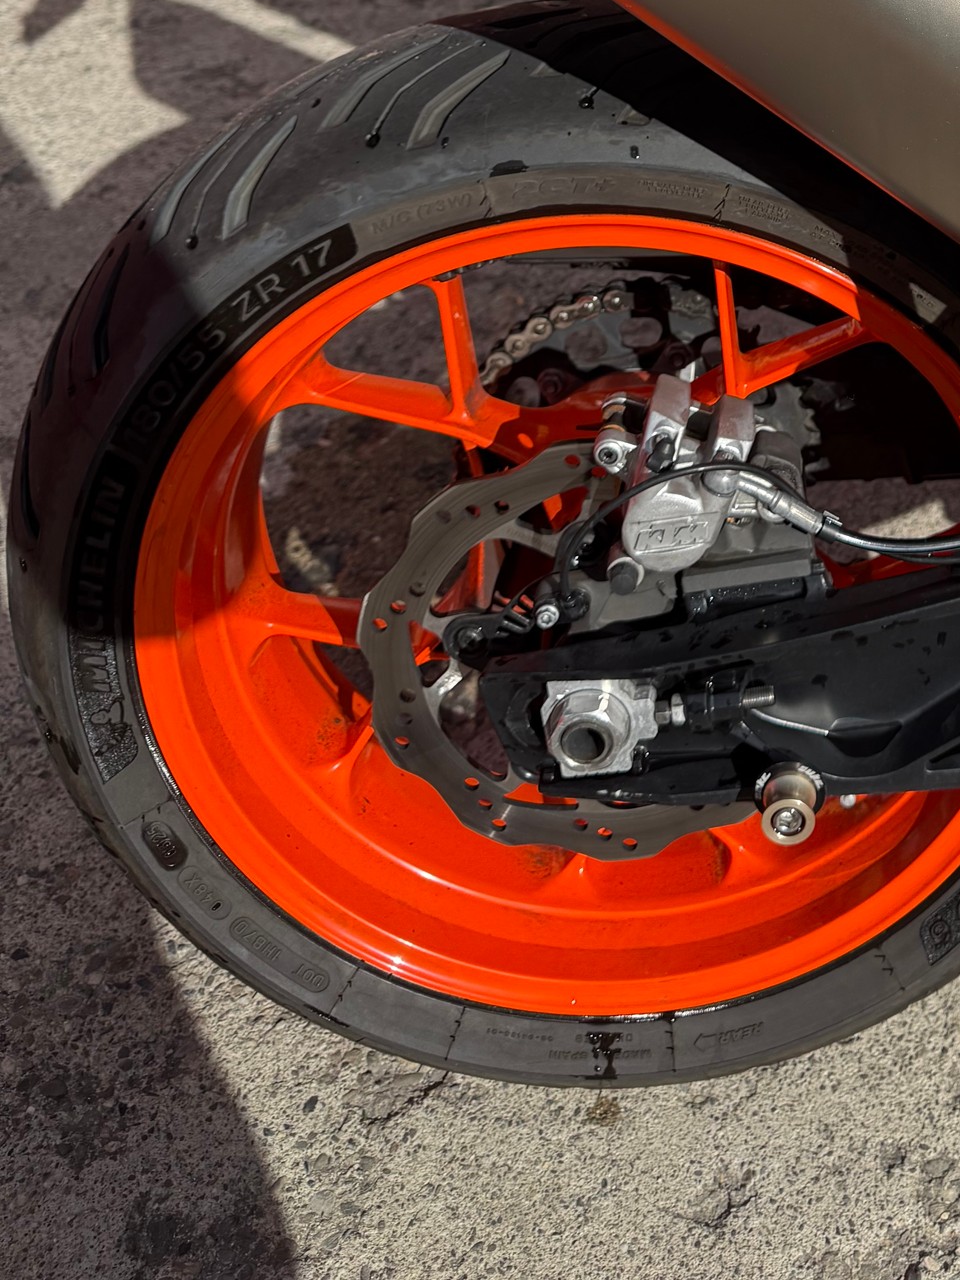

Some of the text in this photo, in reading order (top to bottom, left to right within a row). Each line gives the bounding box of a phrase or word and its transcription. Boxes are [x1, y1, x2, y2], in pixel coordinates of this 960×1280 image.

[231, 273, 286, 321] ZR
[291, 239, 332, 277] 17
[634, 523, 709, 552] KTM
[292, 963, 325, 988] DOT
